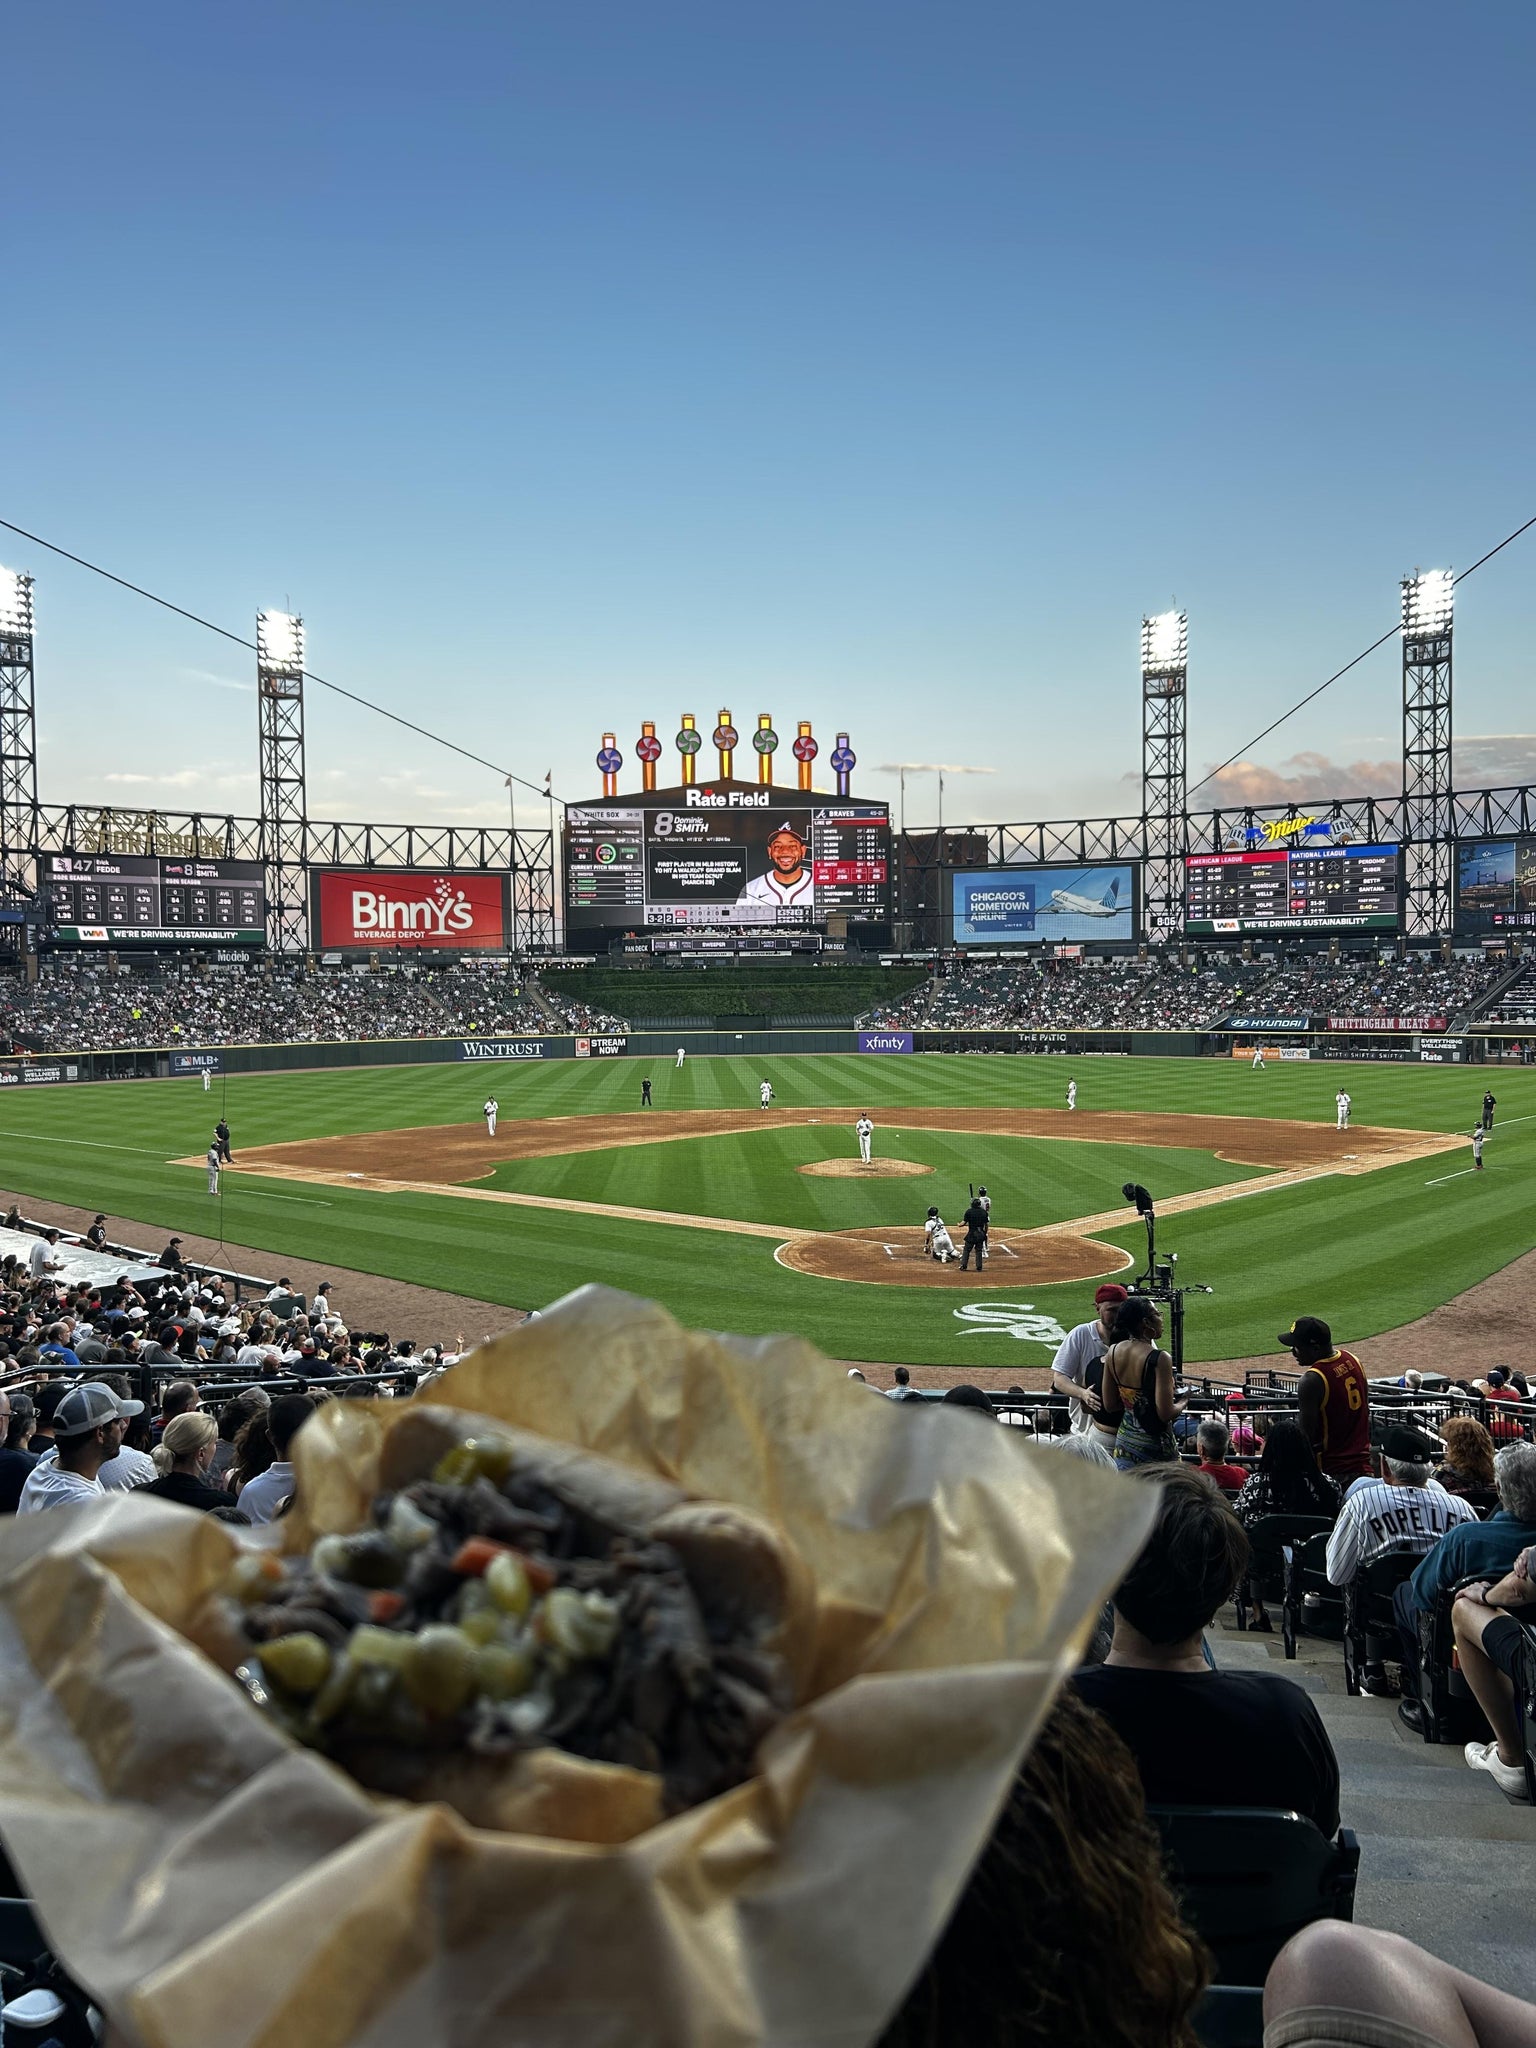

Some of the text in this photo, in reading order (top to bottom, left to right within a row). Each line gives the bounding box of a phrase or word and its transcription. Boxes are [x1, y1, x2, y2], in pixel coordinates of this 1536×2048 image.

[686, 788, 770, 807] Rate Field
[84, 811, 169, 828] CAESARS
[654, 812, 674, 836] 8
[674, 816, 704, 824] Dominic
[674, 823, 709, 833] SMITH
[1260, 816, 1316, 843] Miller
[1333, 821, 1350, 835] Lite
[1230, 828, 1247, 841] Lite
[84, 828, 227, 859] SPORTSBOOK
[73, 860, 93, 872] 47
[1189, 857, 1220, 865] AMERICAN
[96, 866, 121, 874] FEDDE
[184, 864, 193, 876] 8
[196, 870, 219, 878] SMITH
[970, 891, 1026, 902] CHICAGO'S
[970, 902, 1030, 912] HOMETOWN
[352, 890, 474, 936] Binny's
[970, 911, 1007, 922] AIRLINE
[648, 915, 672, 923] 3-2 2
[1156, 917, 1176, 926] 8:06
[1243, 920, 1268, 928] WE'RE
[1269, 919, 1301, 928] DRIVING
[113, 930, 140, 938] WE'RE
[141, 930, 174, 939] DRIVING
[353, 930, 426, 939] BEVERAGE DEPOT
[635, 944, 649, 952] DECK
[217, 949, 250, 962] Modelo
[1330, 1018, 1395, 1029] WHITTINGHAM
[1398, 1018, 1430, 1029] MEATS
[1018, 1033, 1067, 1041] THE PATIO
[591, 1038, 626, 1048] STREAM
[865, 1036, 905, 1050] xfinity
[463, 1042, 544, 1056] WINTRUST
[599, 1046, 619, 1055] NOW
[192, 1055, 219, 1066] MLB+
[1420, 1051, 1443, 1061] Rate
[1344, 1376, 1362, 1411] 6
[1369, 1506, 1425, 1543] POPE
